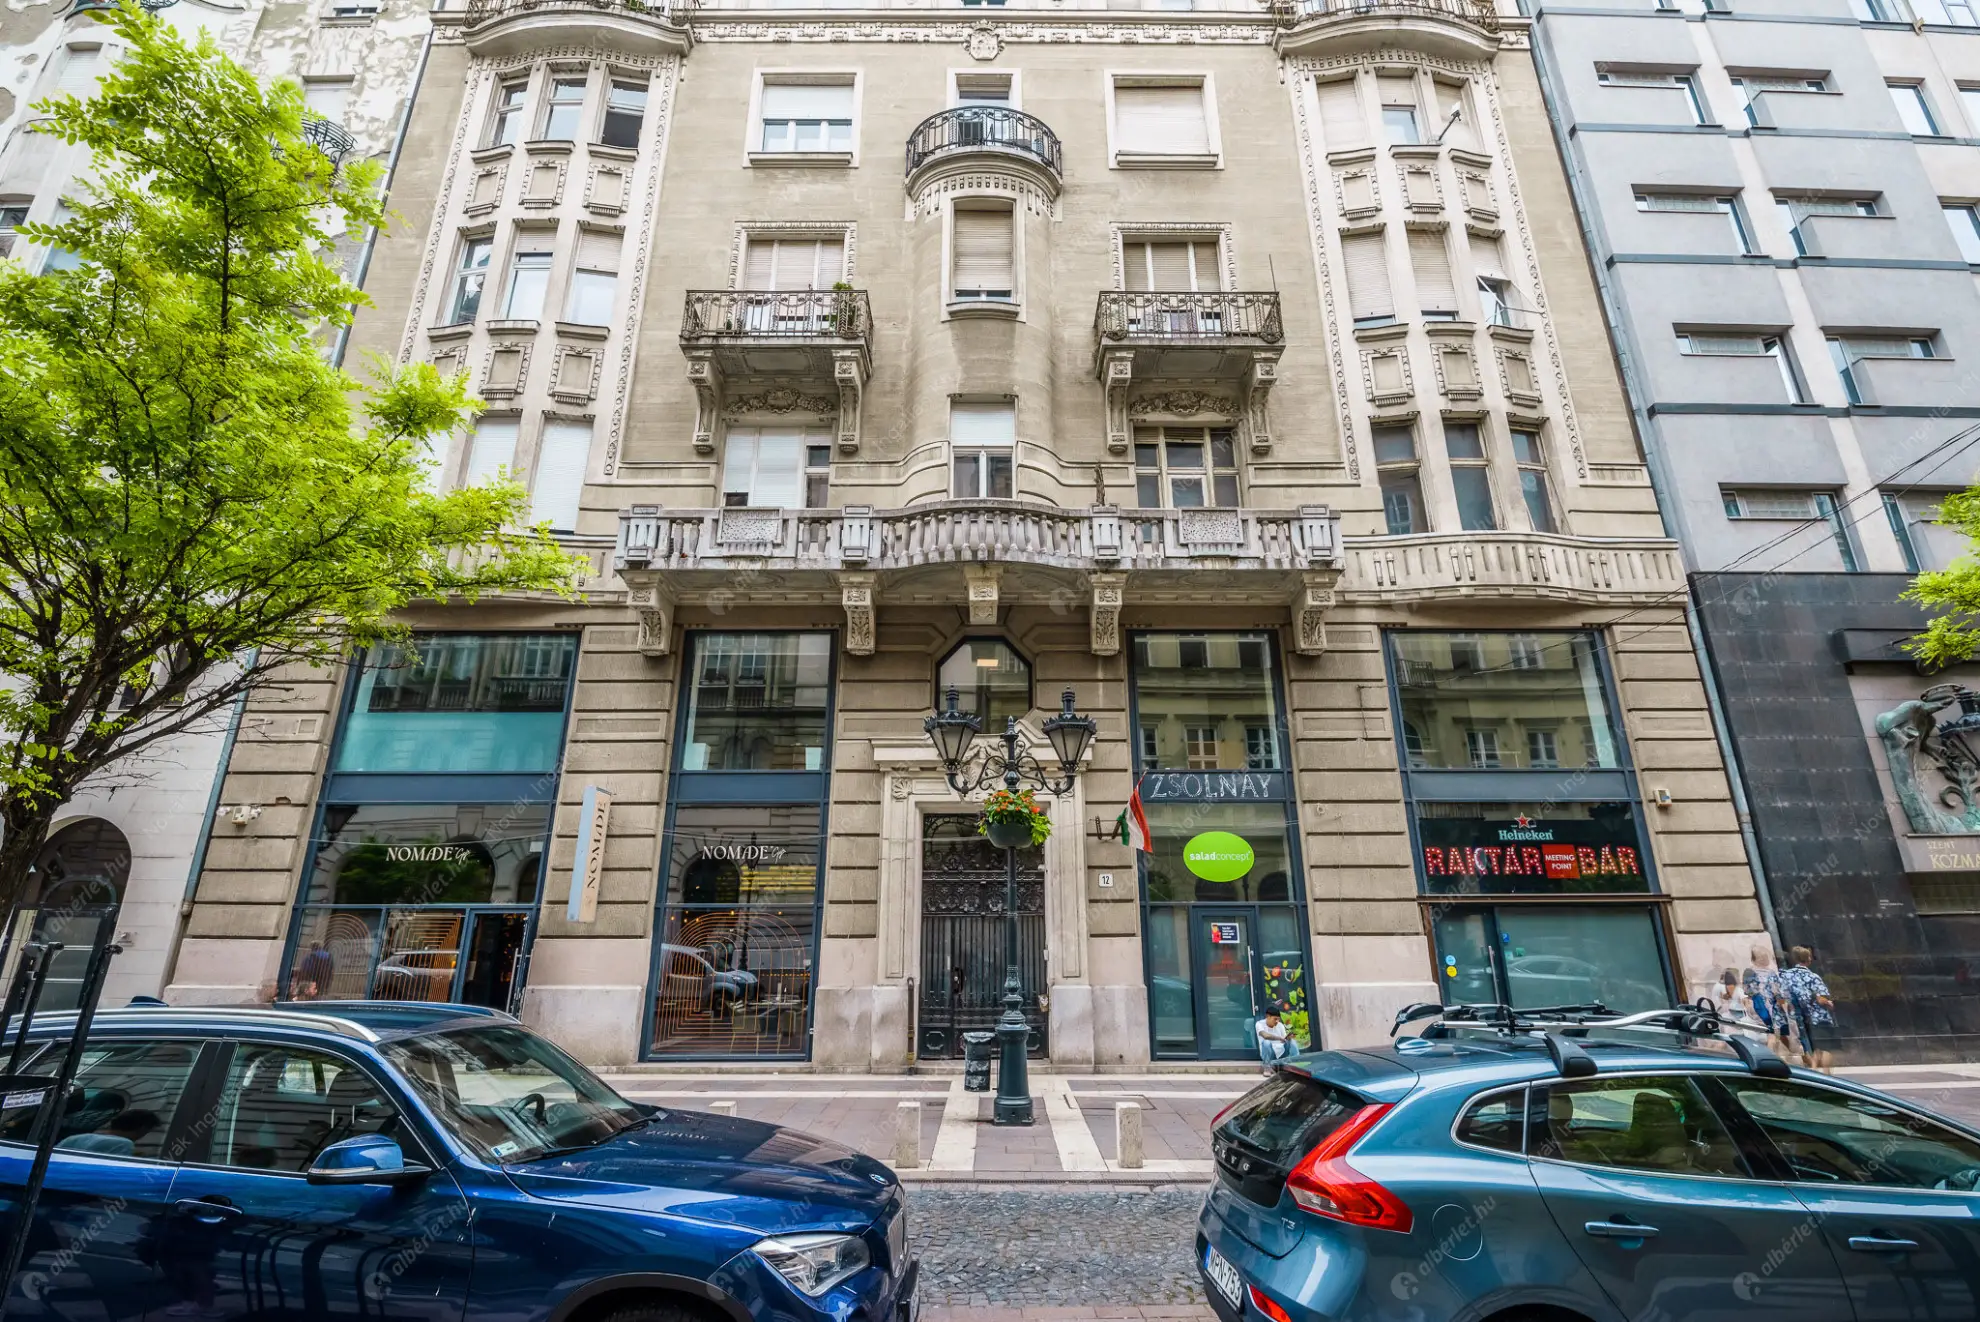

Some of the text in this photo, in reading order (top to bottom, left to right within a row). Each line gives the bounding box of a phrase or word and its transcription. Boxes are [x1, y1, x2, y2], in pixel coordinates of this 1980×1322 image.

[1150, 773, 1272, 798] ZSOLNAY
[1498, 829, 1553, 841] Heineken
[587, 801, 606, 889] NOMADE
[1926, 840, 1955, 849] SZENT
[385, 846, 454, 862] NOMADE
[701, 845, 769, 860] NOMADE
[1425, 844, 1640, 875] RAKTÁR BÁR
[1545, 854, 1575, 862] MEETING
[1102, 876, 1110, 885] 12
[1281, 1217, 1296, 1230] T3
